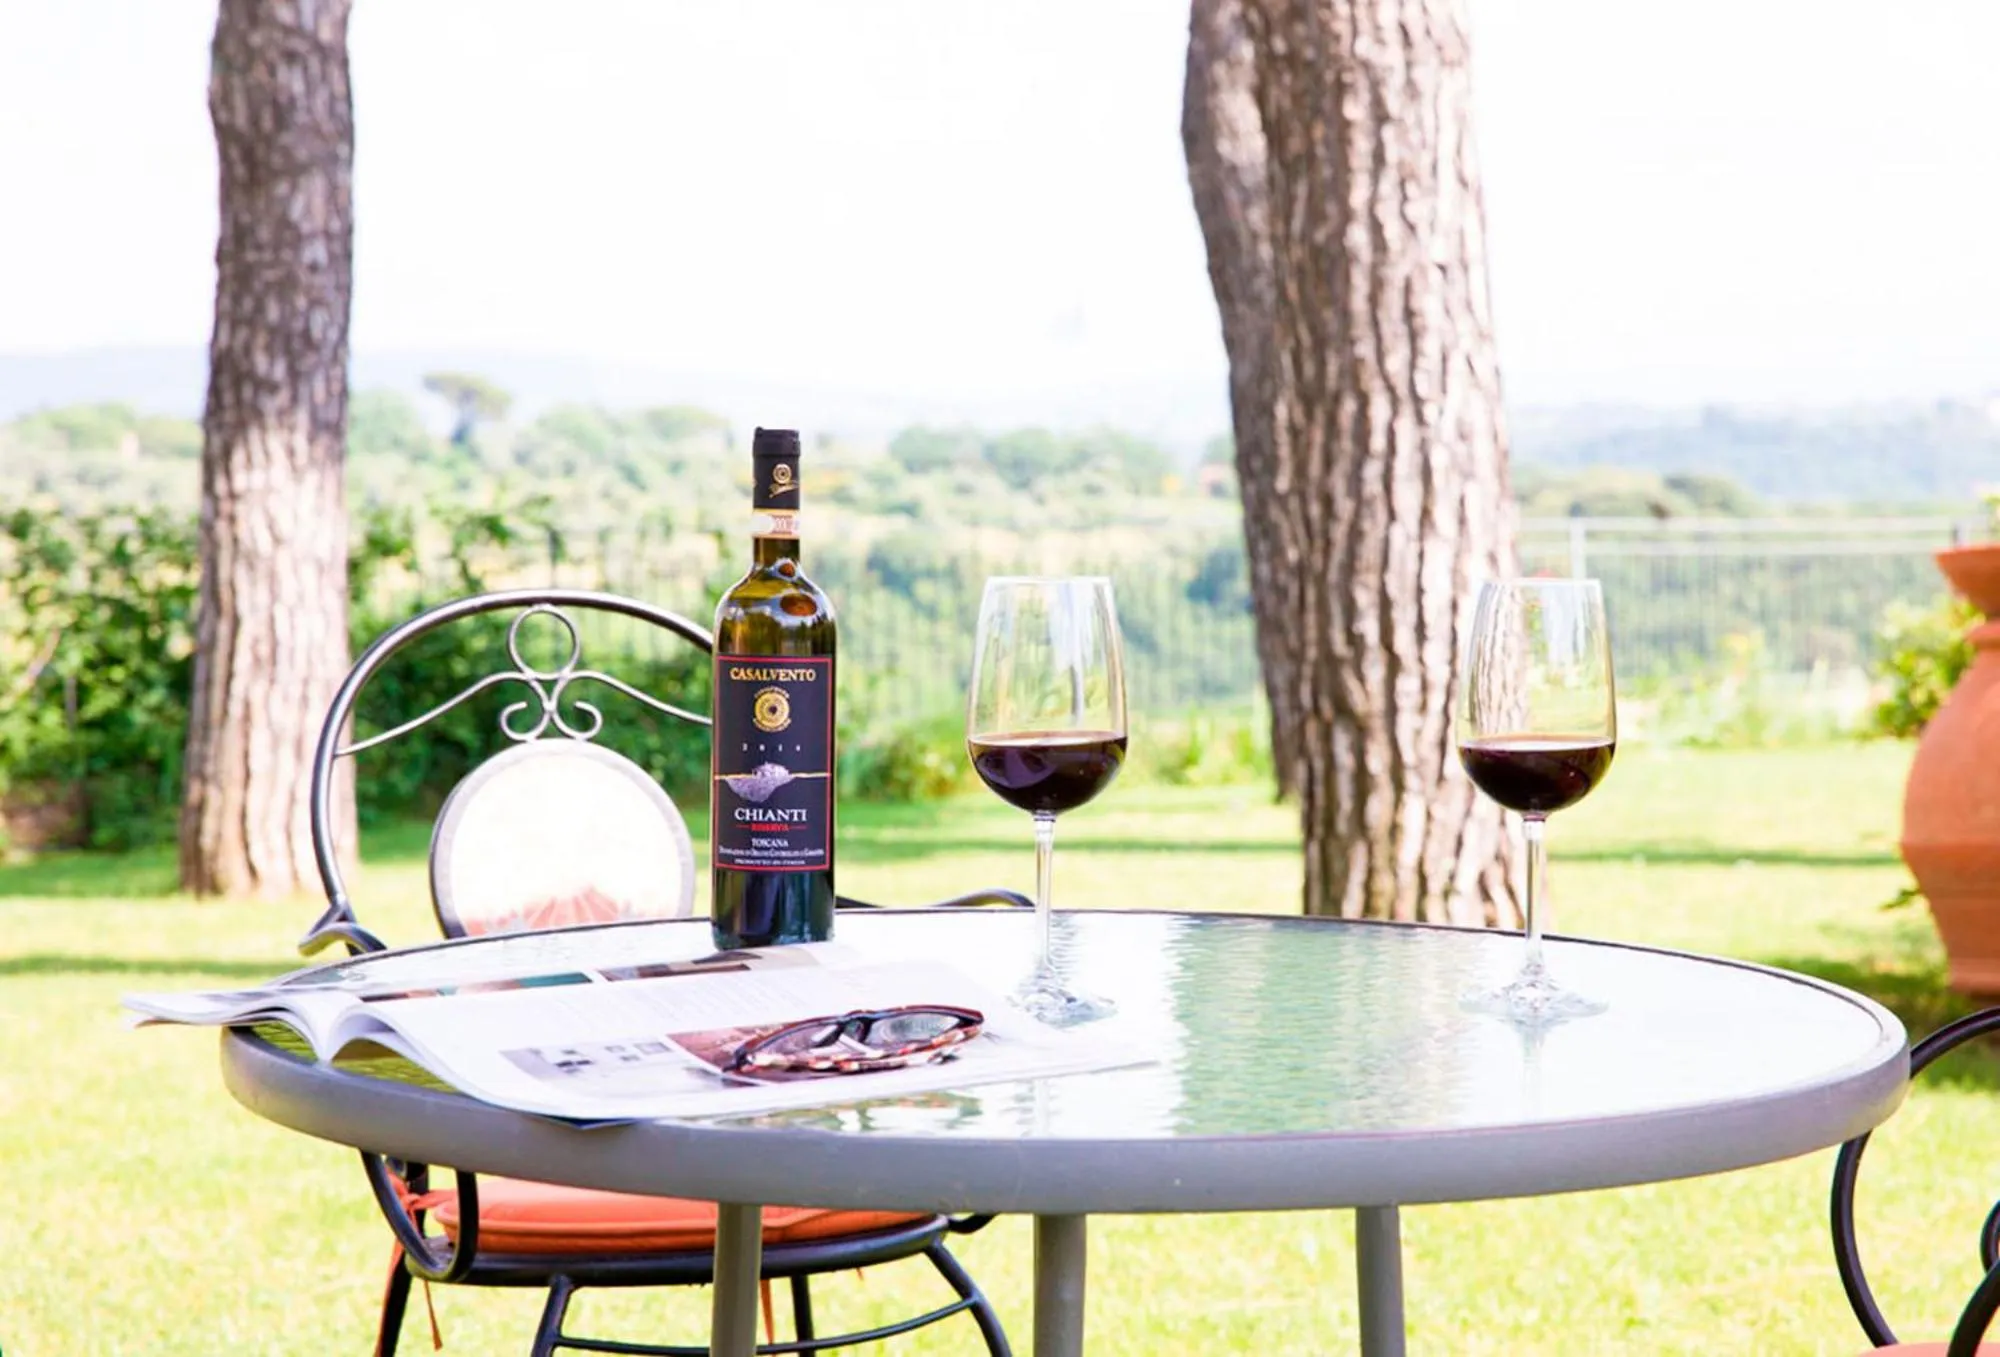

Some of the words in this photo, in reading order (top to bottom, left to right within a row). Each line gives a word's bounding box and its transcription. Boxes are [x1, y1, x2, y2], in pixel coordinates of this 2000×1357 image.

[730, 667, 816, 681] CASALVENTO
[734, 807, 808, 821] CHIANTI
[751, 838, 789, 848] TOSCANA
